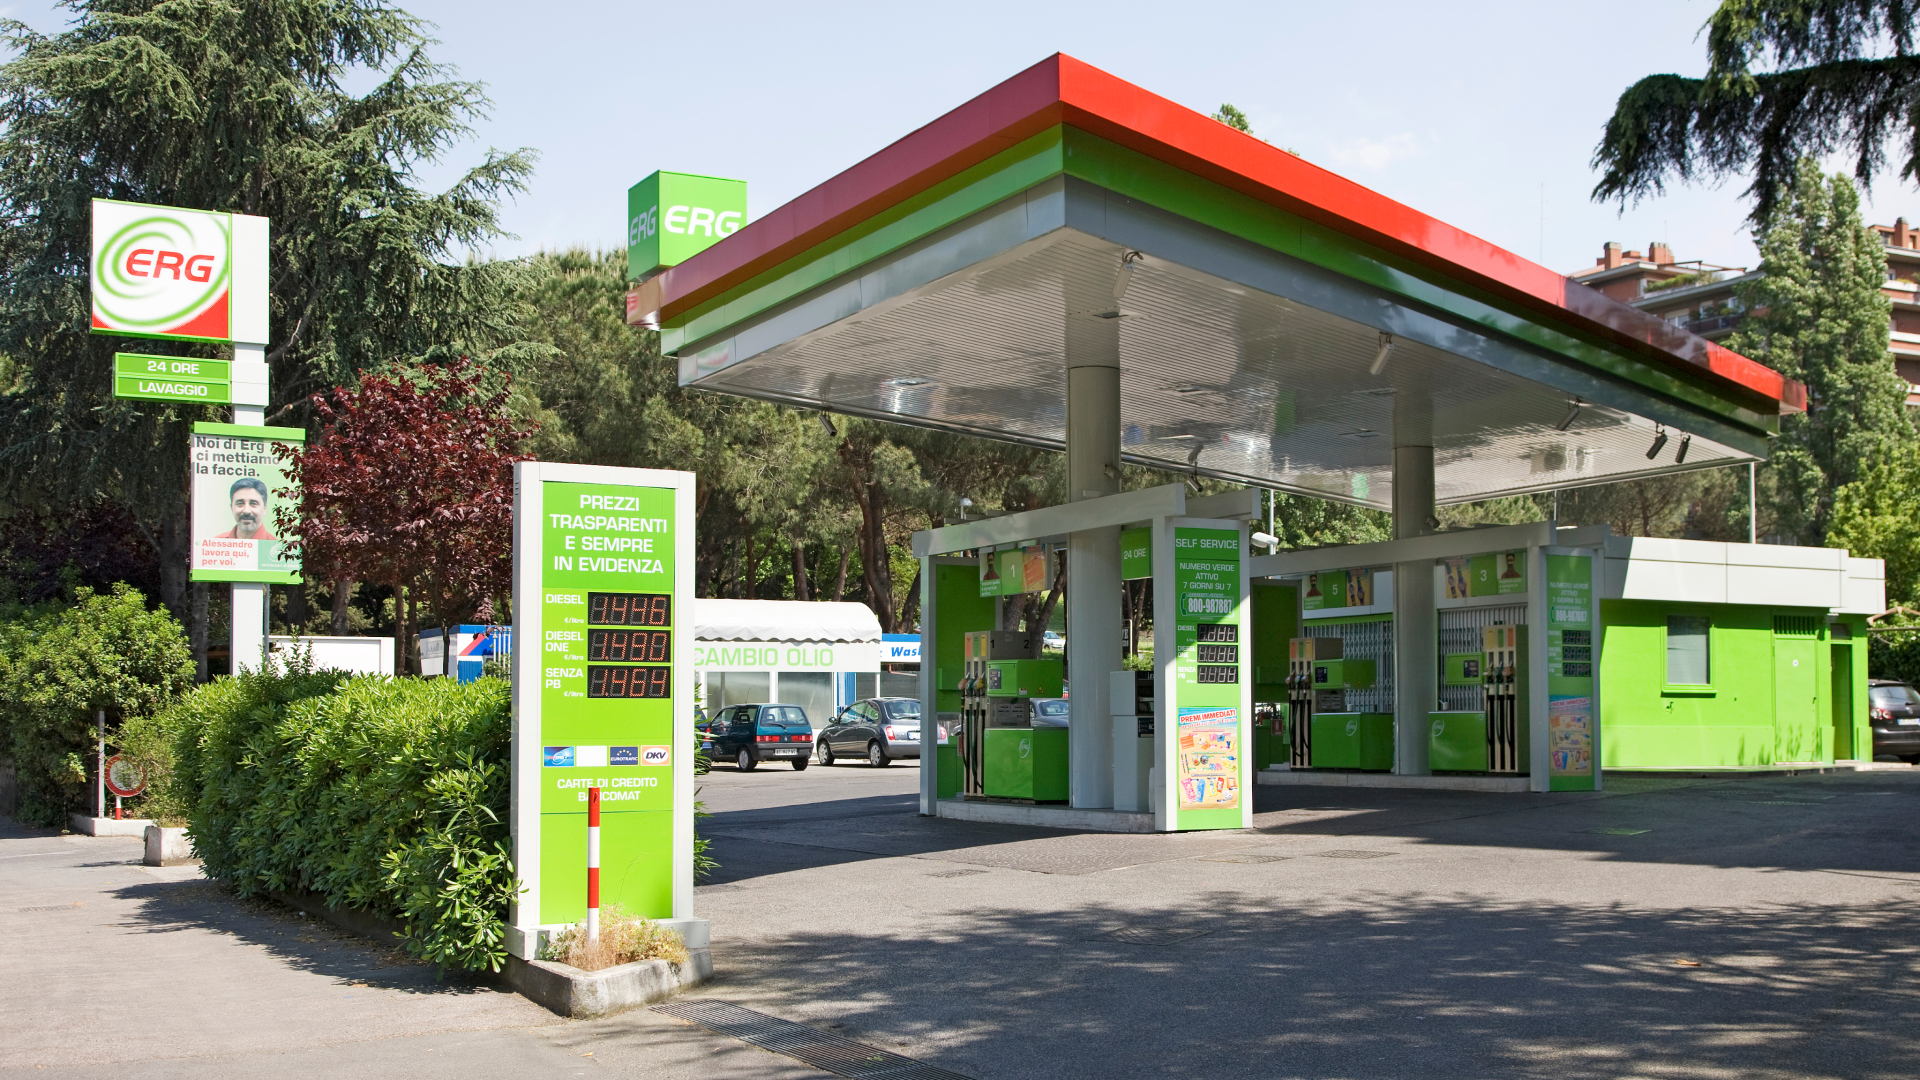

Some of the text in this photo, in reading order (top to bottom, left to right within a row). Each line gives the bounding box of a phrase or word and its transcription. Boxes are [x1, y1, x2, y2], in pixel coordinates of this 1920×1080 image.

[629, 205, 657, 247] ERG
[664, 205, 742, 238] ERG
[126, 249, 215, 283] ERG
[147, 361, 199, 374] 24 ORE
[139, 382, 207, 396] LAVAGGIO
[196, 436, 265, 454] Noi di Erg
[196, 450, 280, 465] ci mettiamo
[196, 463, 260, 477] la faccia.
[580, 494, 639, 511] PREZZI
[549, 513, 667, 533] TRASPARENTI
[202, 539, 253, 548] Alessandro
[565, 536, 653, 553] E SEMPRE
[1175, 538, 1238, 549] SELF SERVICE
[202, 548, 249, 558] lavora qui,
[1123, 548, 1147, 560] 24 ORE
[219, 558, 236, 566] voi.
[554, 556, 664, 574] IN EVIDENZA
[1179, 562, 1235, 572] NUMERO VERDE
[1011, 565, 1015, 577] 1
[1195, 572, 1219, 580] ATTIVO
[1480, 569, 1487, 582] 3
[1189, 582, 1213, 590] GIORNI
[1332, 584, 1338, 595] 5
[546, 594, 584, 604] DIESEL
[1188, 598, 1232, 613] 800-987887
[546, 631, 584, 641] DIESEL
[545, 642, 569, 652] ONE
[990, 639, 995, 648] 1
[1024, 639, 1030, 649] 2
[694, 647, 833, 666] CAMBIO OLIO
[546, 668, 583, 678] SENZA
[546, 679, 561, 689] PB
[1180, 709, 1236, 724] PREMI IMMEDIATI
[557, 777, 657, 788] CARTE DI CREDITO
[578, 791, 641, 802] BCOMAT
